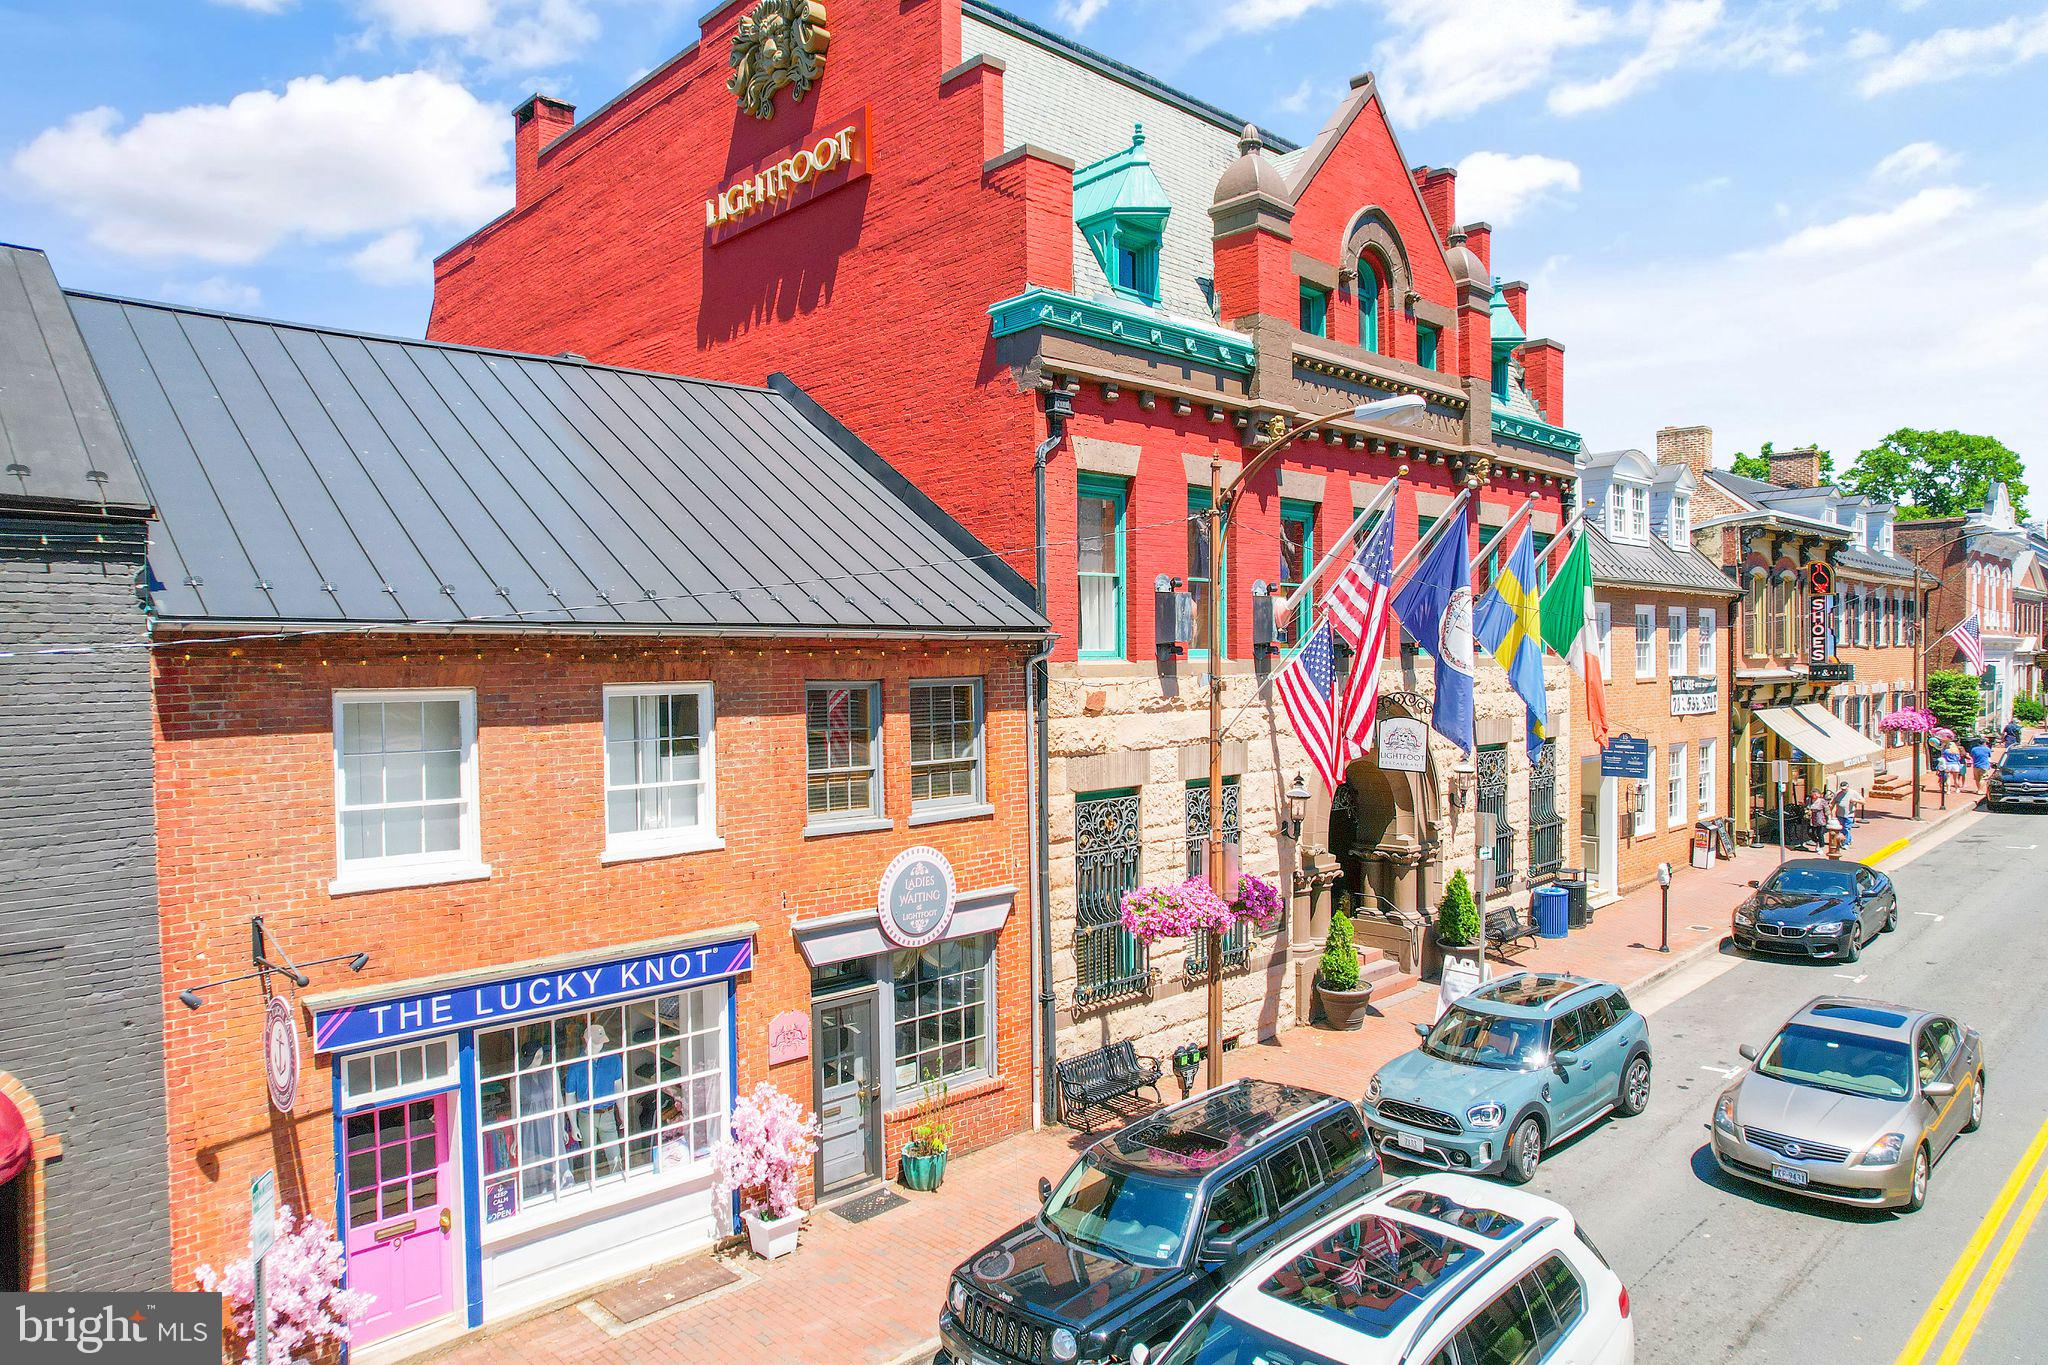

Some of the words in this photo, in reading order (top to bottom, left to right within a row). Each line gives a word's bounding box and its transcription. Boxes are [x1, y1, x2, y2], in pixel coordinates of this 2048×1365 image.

[706, 126, 856, 227] LIGHTFOOT
[1812, 598, 1825, 661] SHOES
[1381, 752, 1425, 761] LIGHTFOOT
[905, 876, 935, 890] LADIES
[898, 890, 941, 907] WAITING
[903, 909, 938, 921] LIGHTFOOT
[368, 995, 453, 1034] THE
[476, 968, 603, 1016] LUCKY
[493, 1190, 508, 1199] KEEP
[492, 1197, 509, 1206] CALM
[491, 1209, 512, 1221] OPEN
